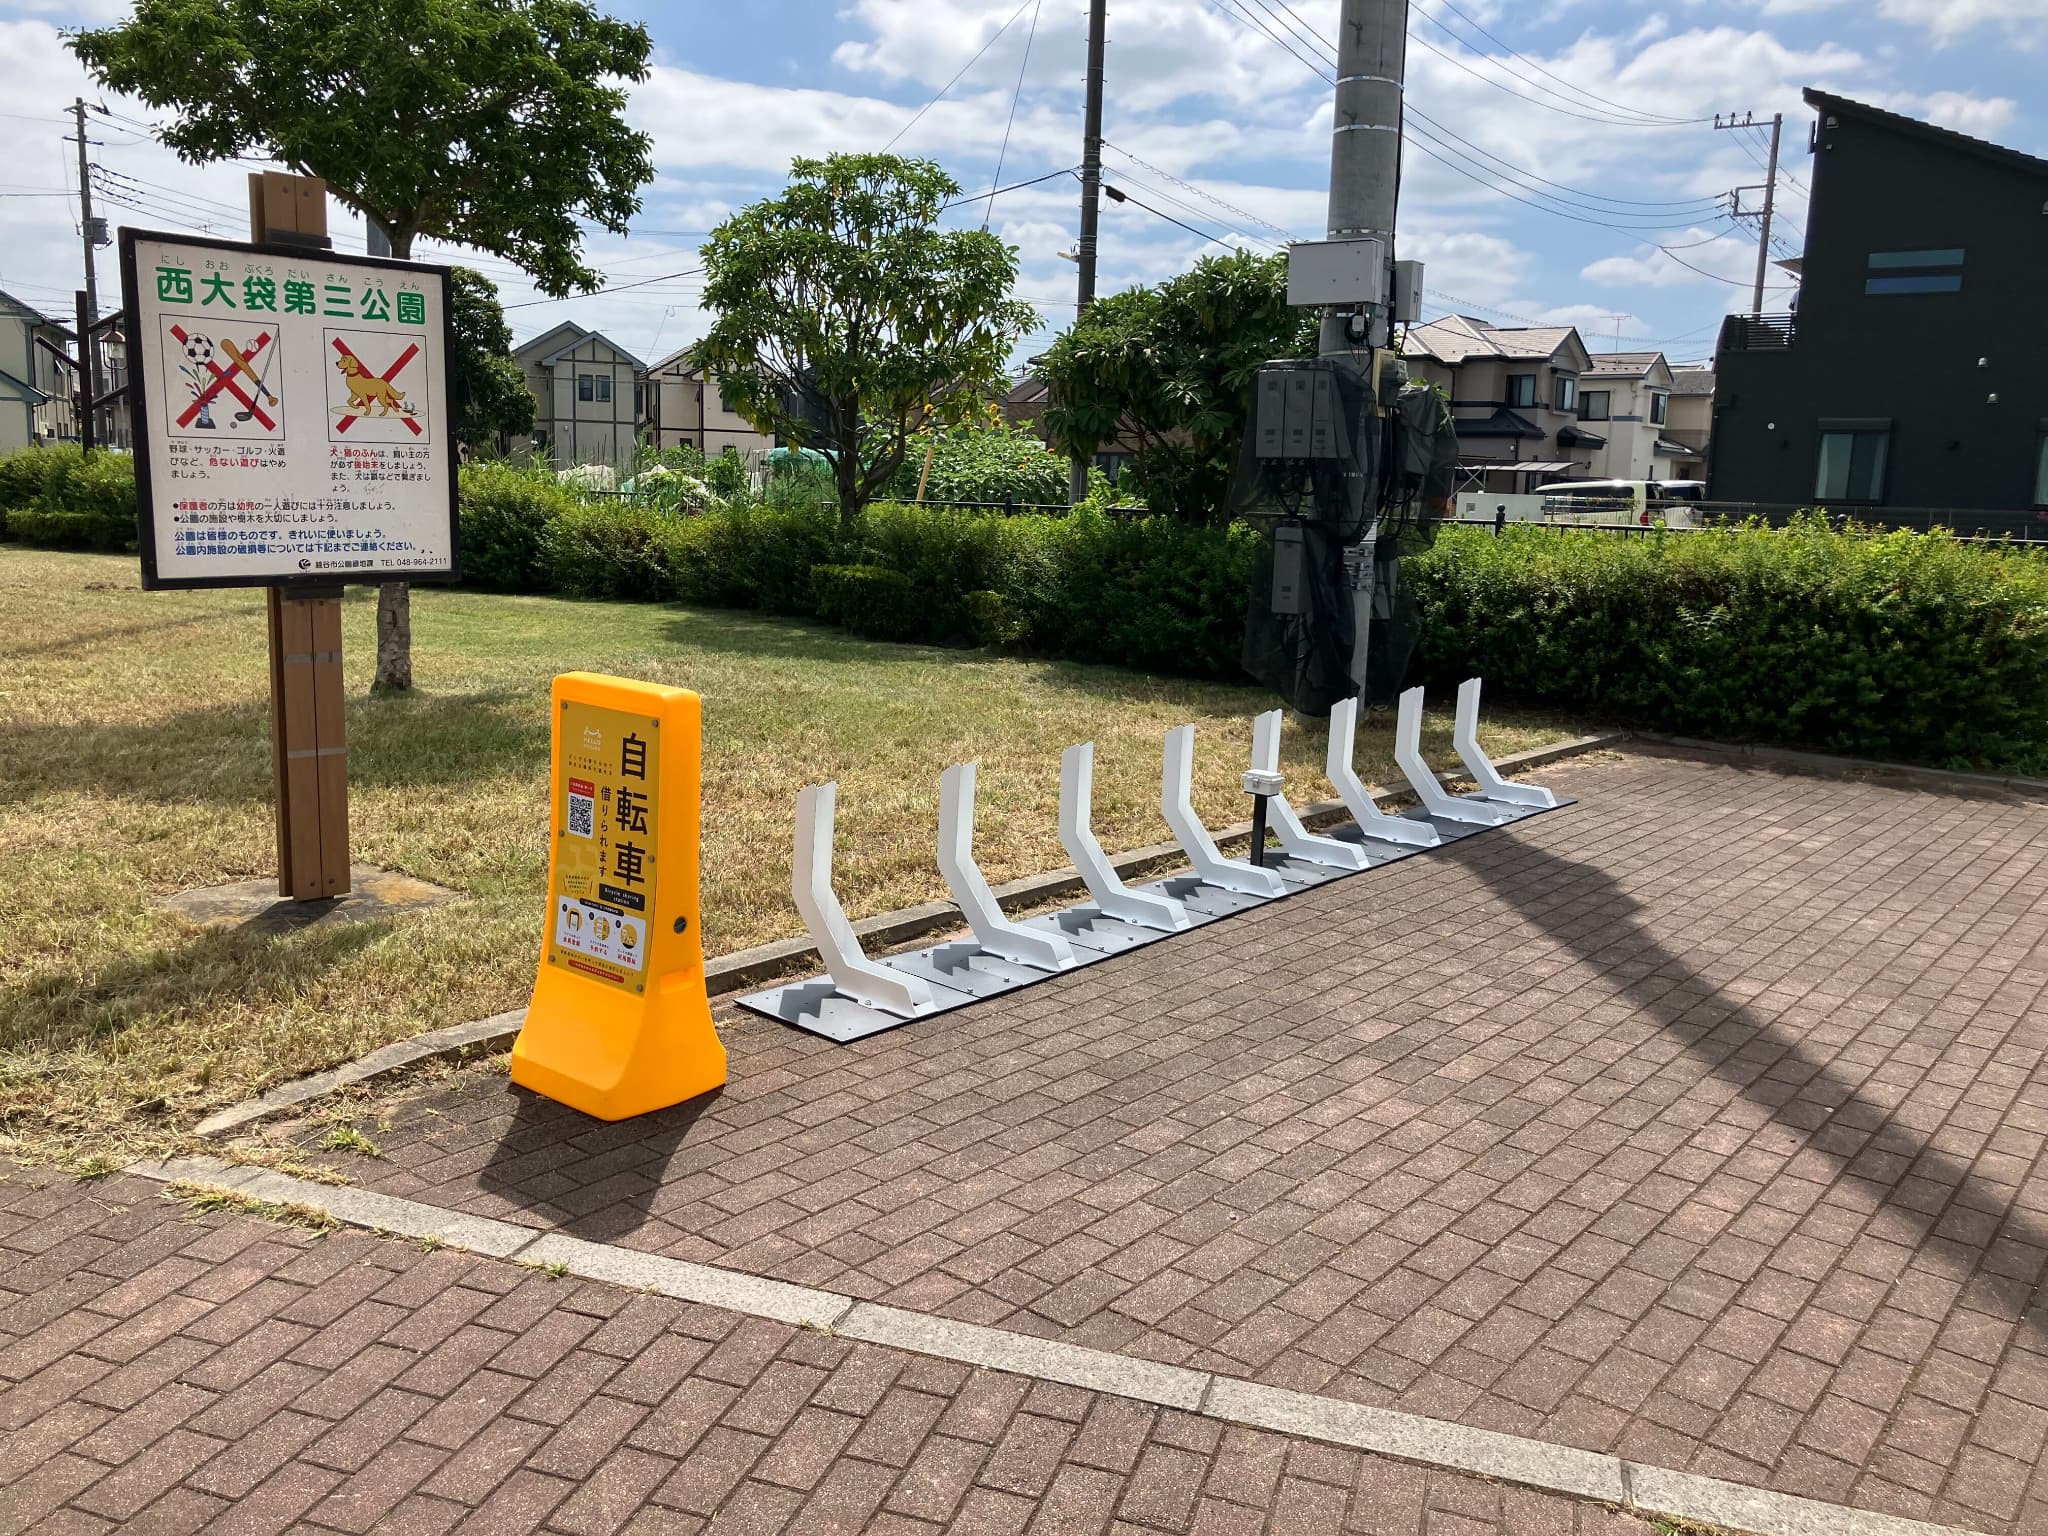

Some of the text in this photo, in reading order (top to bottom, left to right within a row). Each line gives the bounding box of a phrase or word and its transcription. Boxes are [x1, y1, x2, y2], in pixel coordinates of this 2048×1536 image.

[155, 266, 426, 325] 西大袋第三公園
[160, 255, 420, 291] にし おお ぶくろ だい さん こう えん
[598, 785, 612, 877] 借りられます
[613, 732, 648, 886] 自転車
